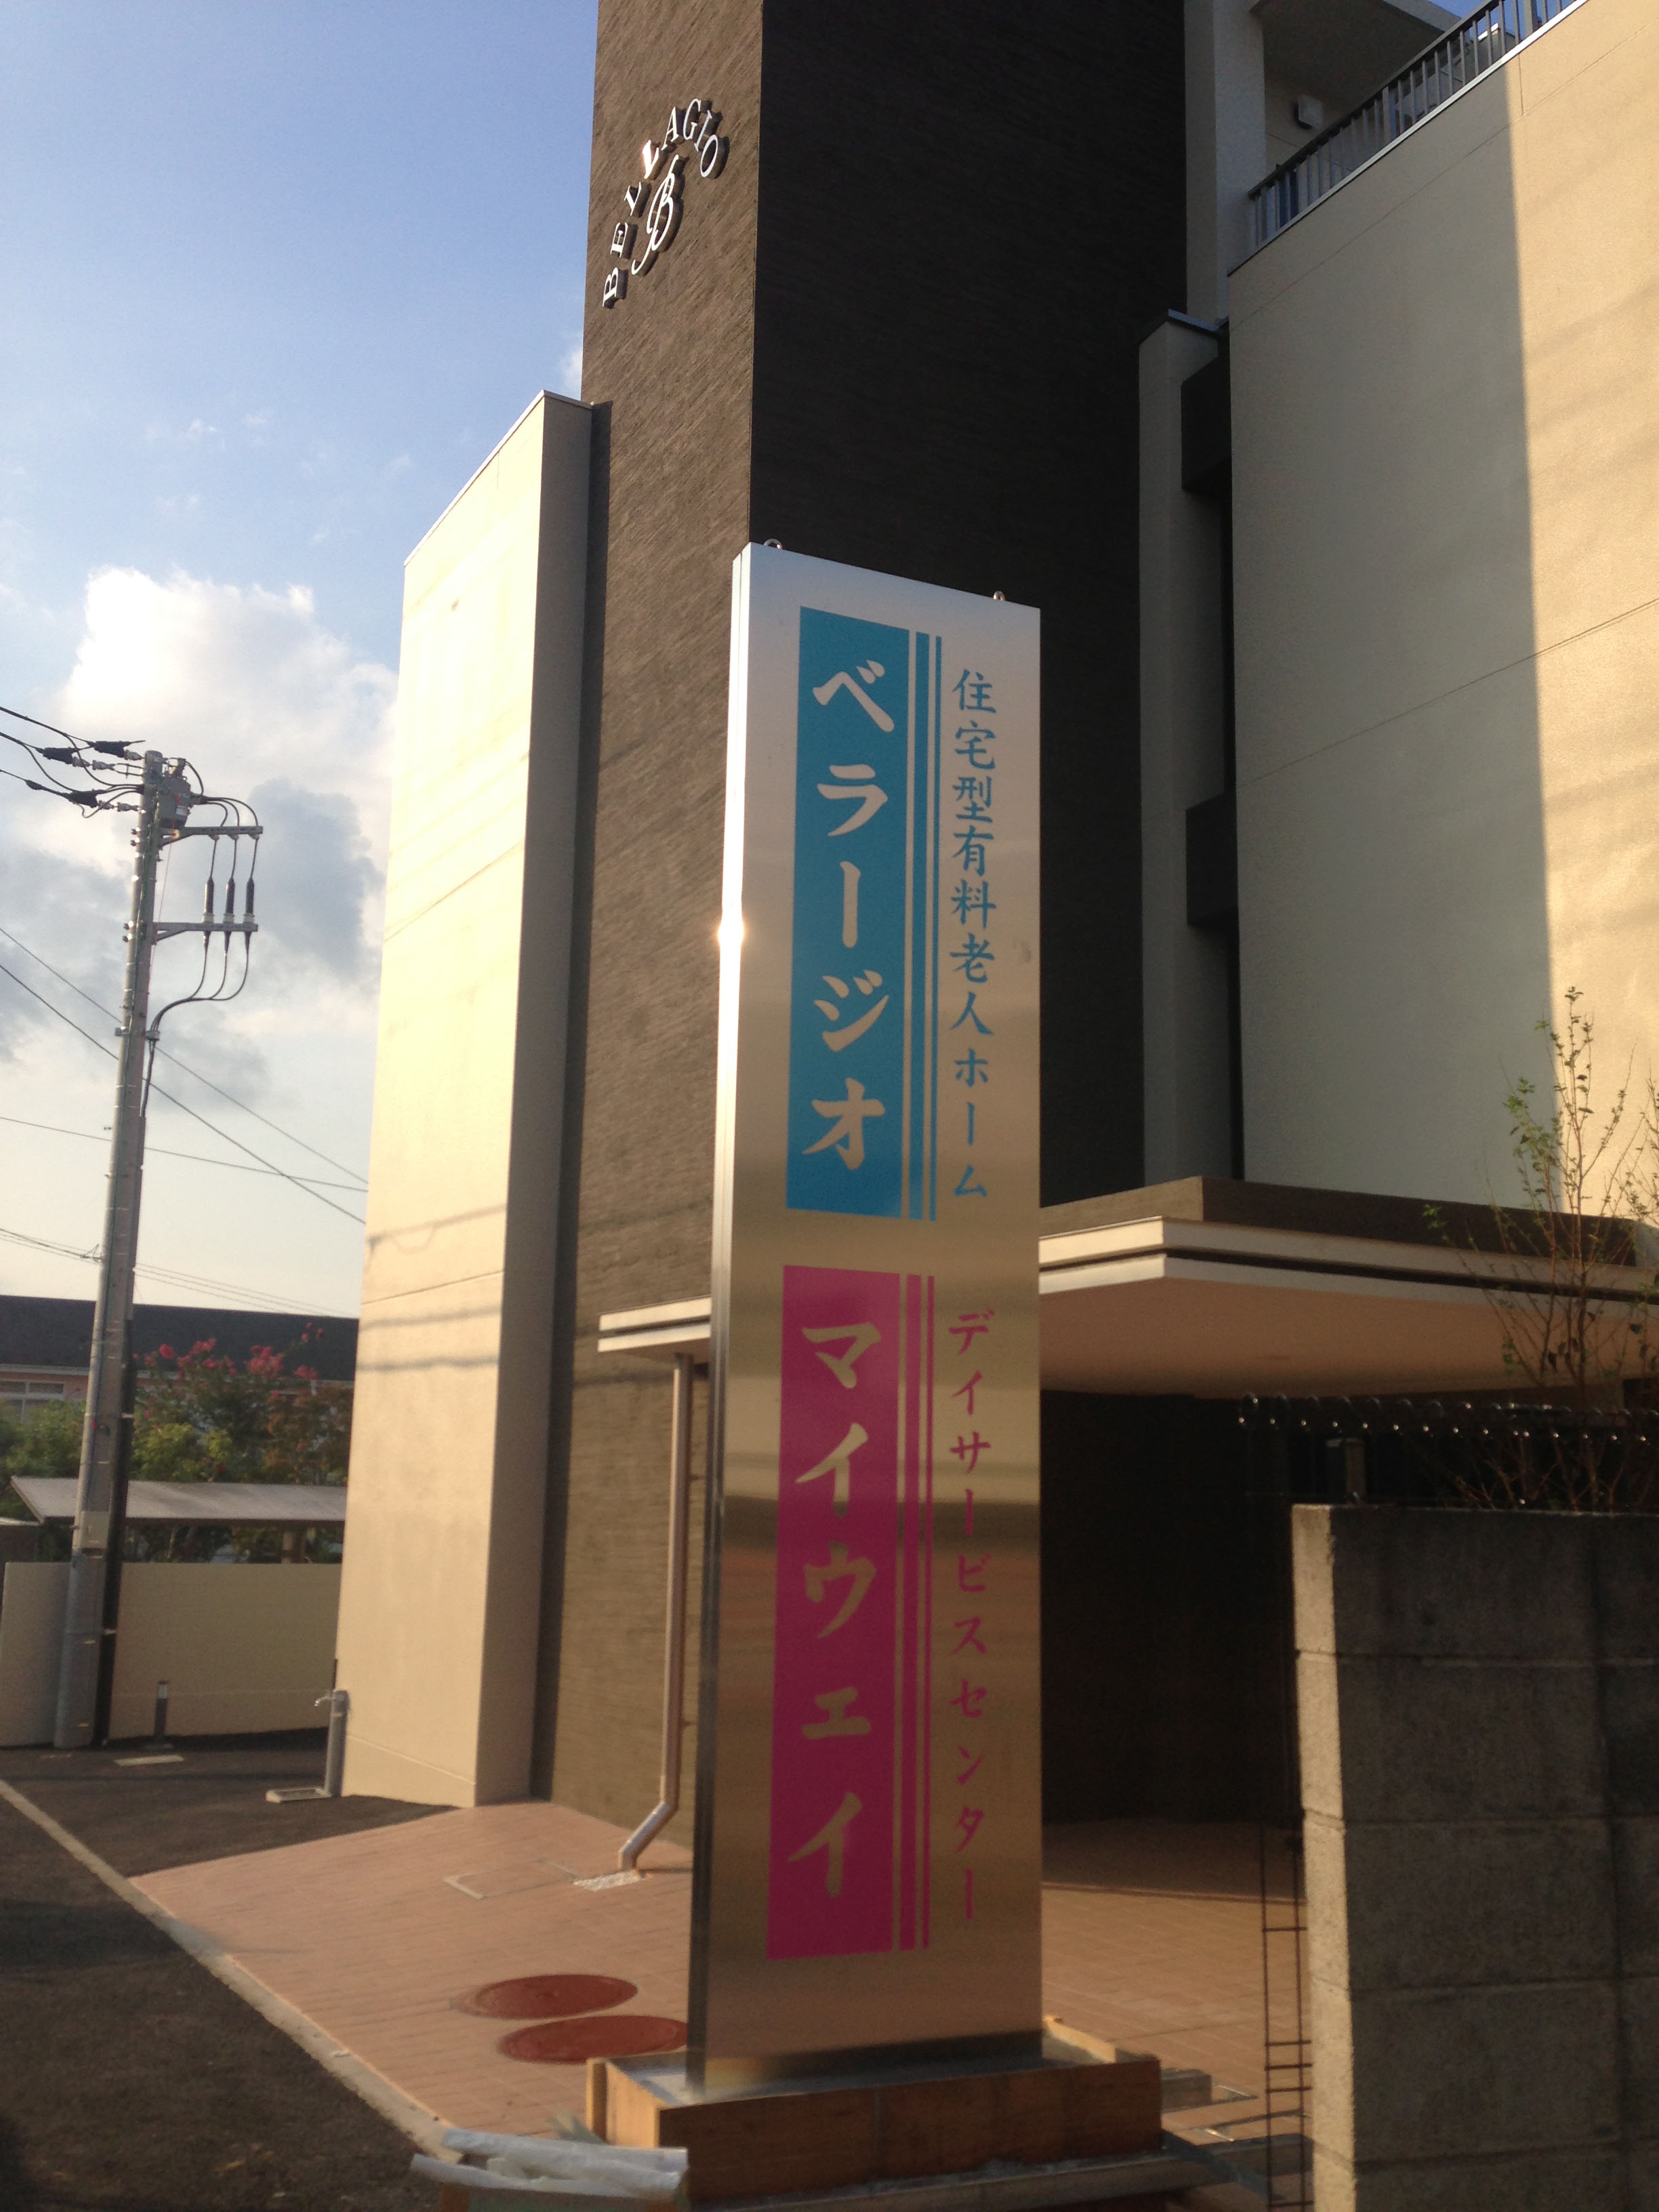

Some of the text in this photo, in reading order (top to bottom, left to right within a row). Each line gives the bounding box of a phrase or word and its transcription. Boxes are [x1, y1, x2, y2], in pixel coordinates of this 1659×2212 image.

[802, 659, 895, 1170] ベラージオ
[949, 668, 997, 1197] 住宅型有料老人ホーム
[949, 1309, 995, 1921] デイサービスセンター
